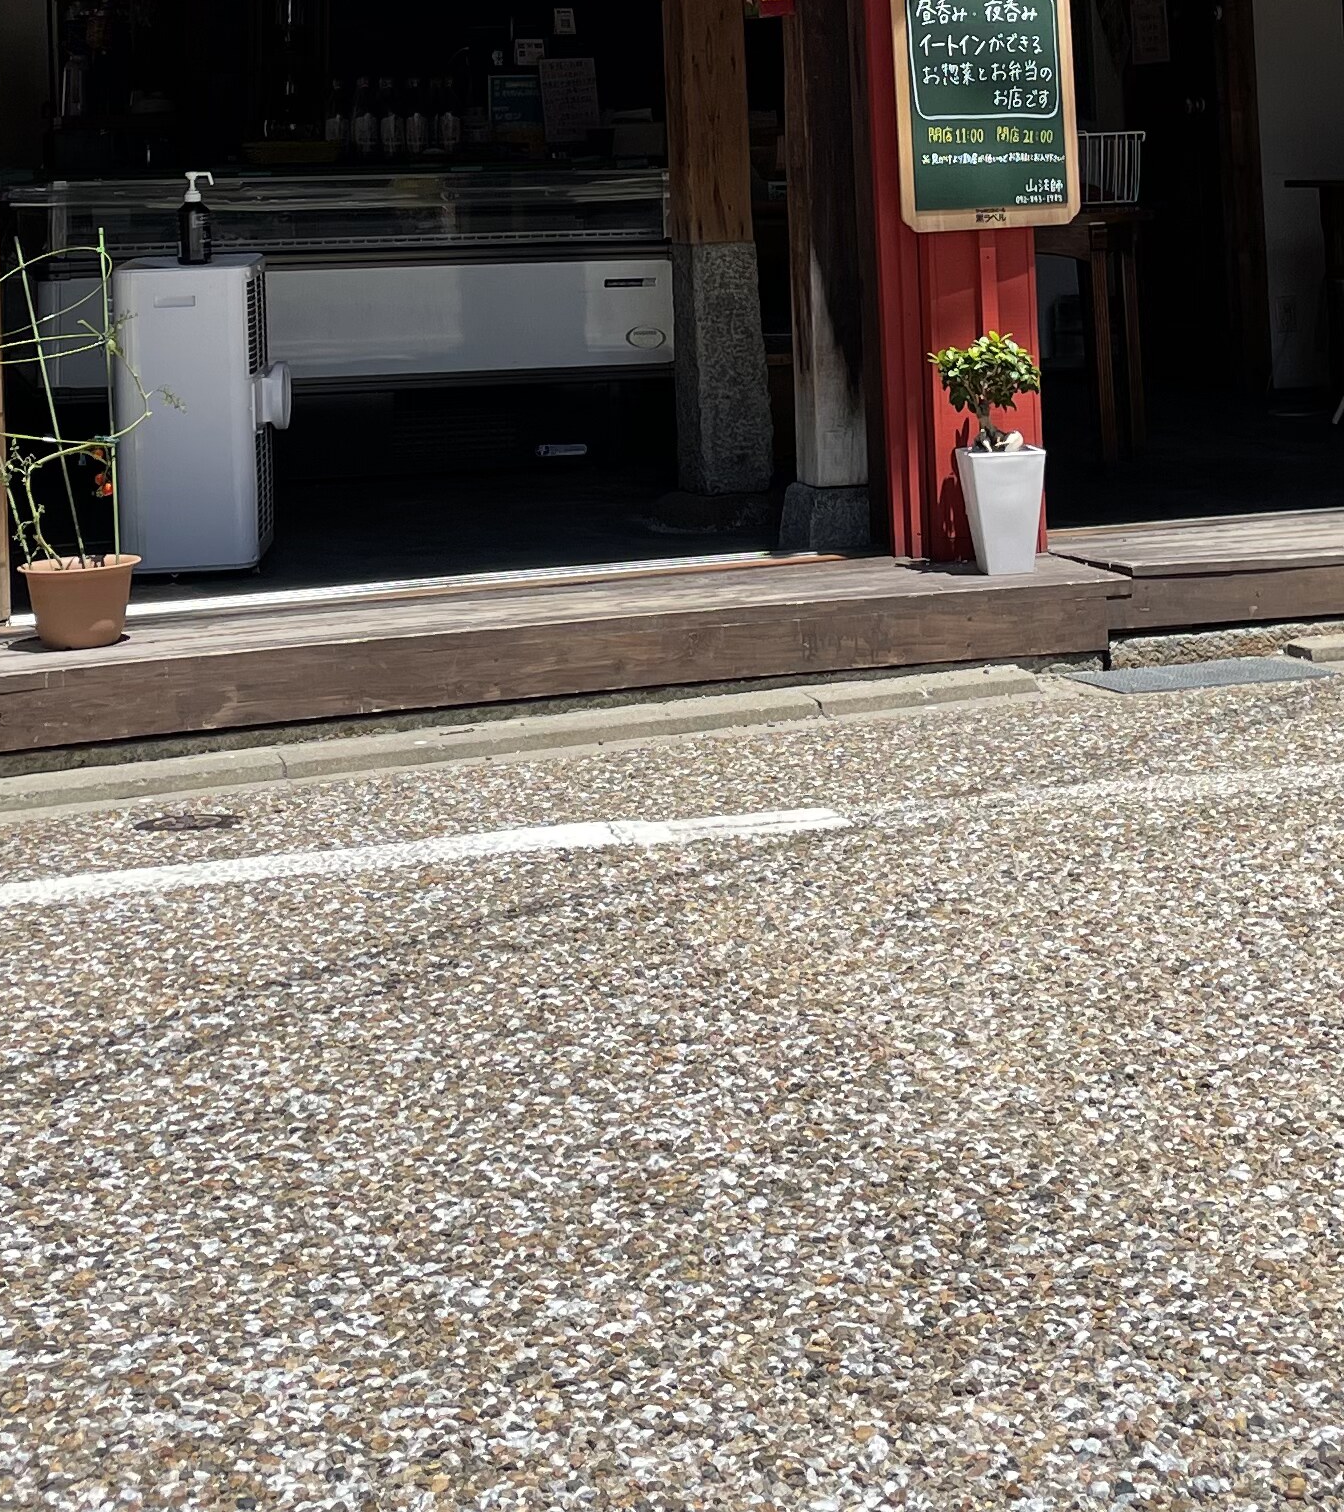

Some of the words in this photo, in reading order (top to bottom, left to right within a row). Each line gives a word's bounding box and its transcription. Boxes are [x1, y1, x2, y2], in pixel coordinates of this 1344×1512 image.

[919, 33, 1043, 56] イートインができる
[922, 60, 1052, 85] お惣菜とお弁当の
[1025, 178, 1064, 193] 山法師
